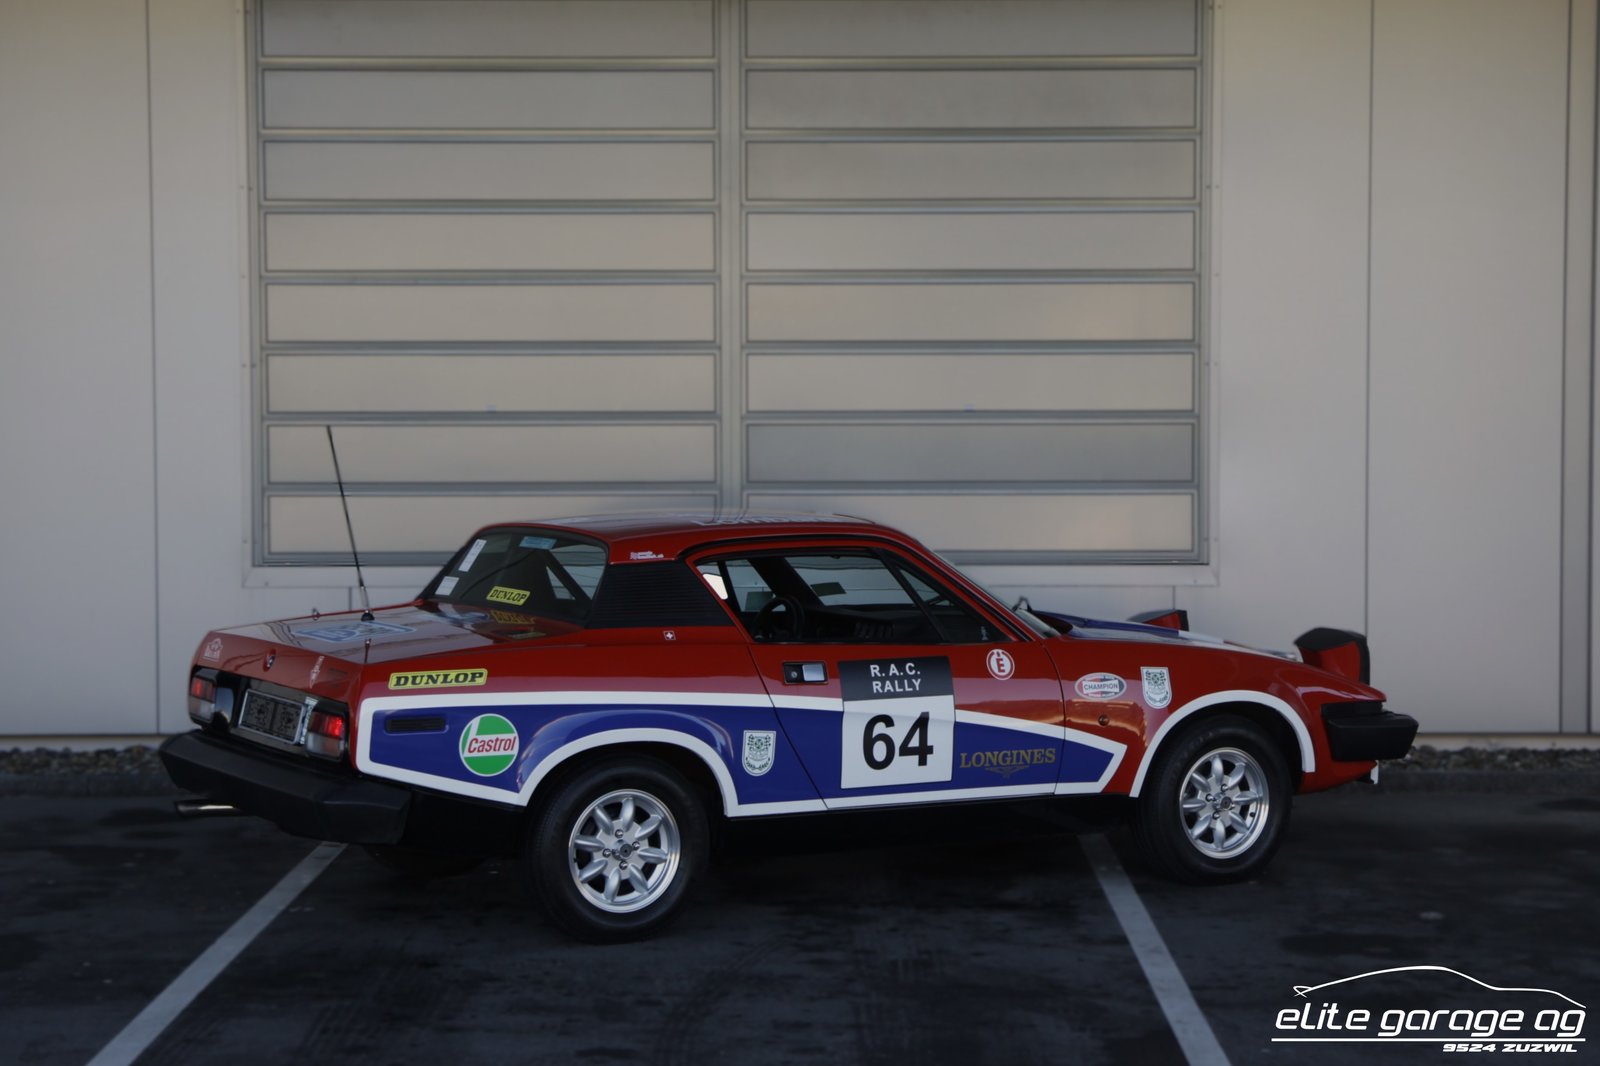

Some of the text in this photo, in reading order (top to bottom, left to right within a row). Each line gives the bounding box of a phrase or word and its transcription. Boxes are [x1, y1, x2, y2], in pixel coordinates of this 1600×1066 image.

[489, 588, 527, 602] DUNLOP
[394, 671, 484, 687] DUNLOP
[872, 678, 922, 693] RALLY
[1083, 680, 1119, 691] CHAMPION
[467, 735, 517, 754] Castrol
[862, 711, 934, 771] 64
[959, 748, 1057, 769] LONGINES
